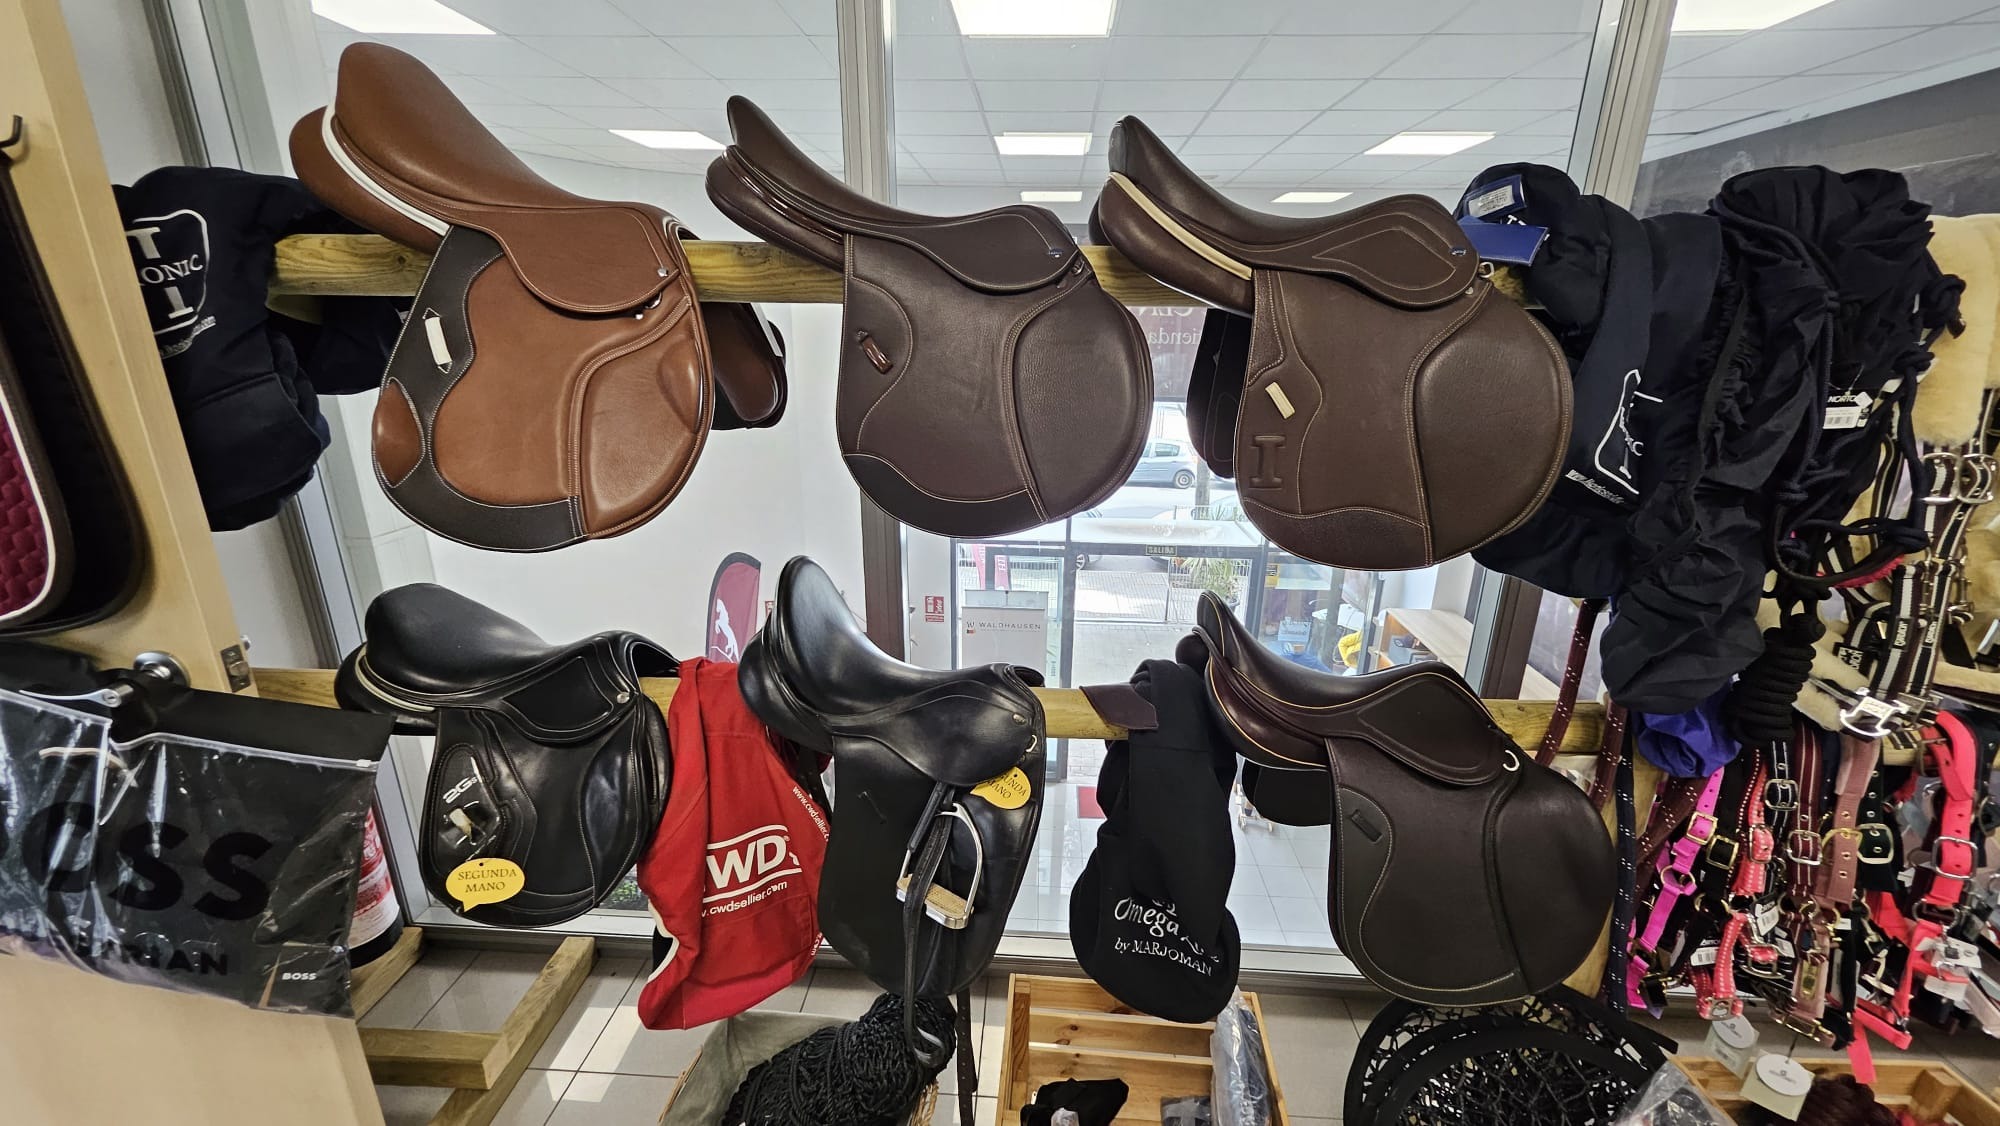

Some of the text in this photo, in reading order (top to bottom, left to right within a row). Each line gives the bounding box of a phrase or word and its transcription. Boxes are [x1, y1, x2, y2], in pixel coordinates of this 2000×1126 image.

[140, 254, 203, 286] ONIC
[793, 786, 829, 842] www.cwdsellier.c
[0, 801, 273, 920] OSS
[458, 869, 517, 881] SEGUNDA
[705, 835, 787, 889] WD
[465, 882, 506, 893] MANO
[1114, 897, 1179, 937] Omega
[1115, 937, 1130, 954] by
[1132, 940, 1212, 976] MARJOMAN
[282, 972, 317, 981] BOSS
